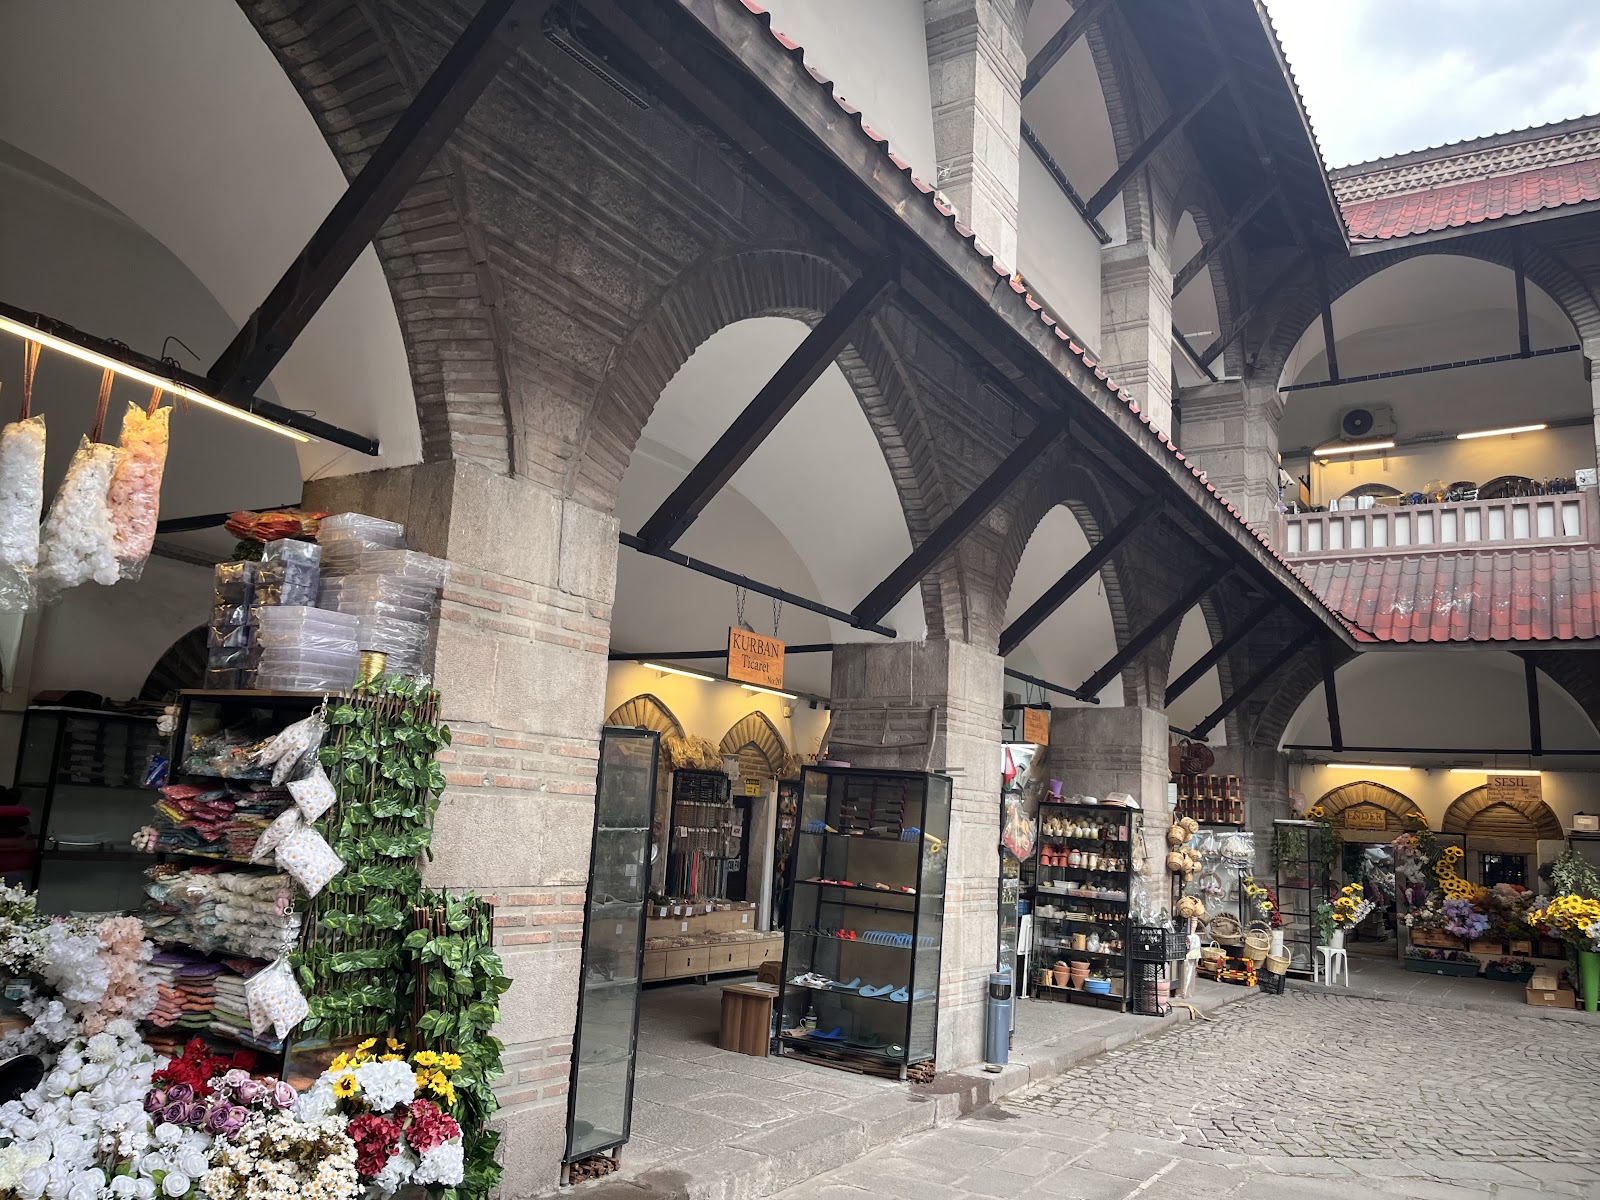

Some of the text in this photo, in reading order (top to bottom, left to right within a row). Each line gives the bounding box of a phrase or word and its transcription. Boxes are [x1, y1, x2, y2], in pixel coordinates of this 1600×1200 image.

[733, 633, 780, 658] KURBAN
[742, 654, 769, 673] Ticaret
[1347, 810, 1382, 820] ENDER
